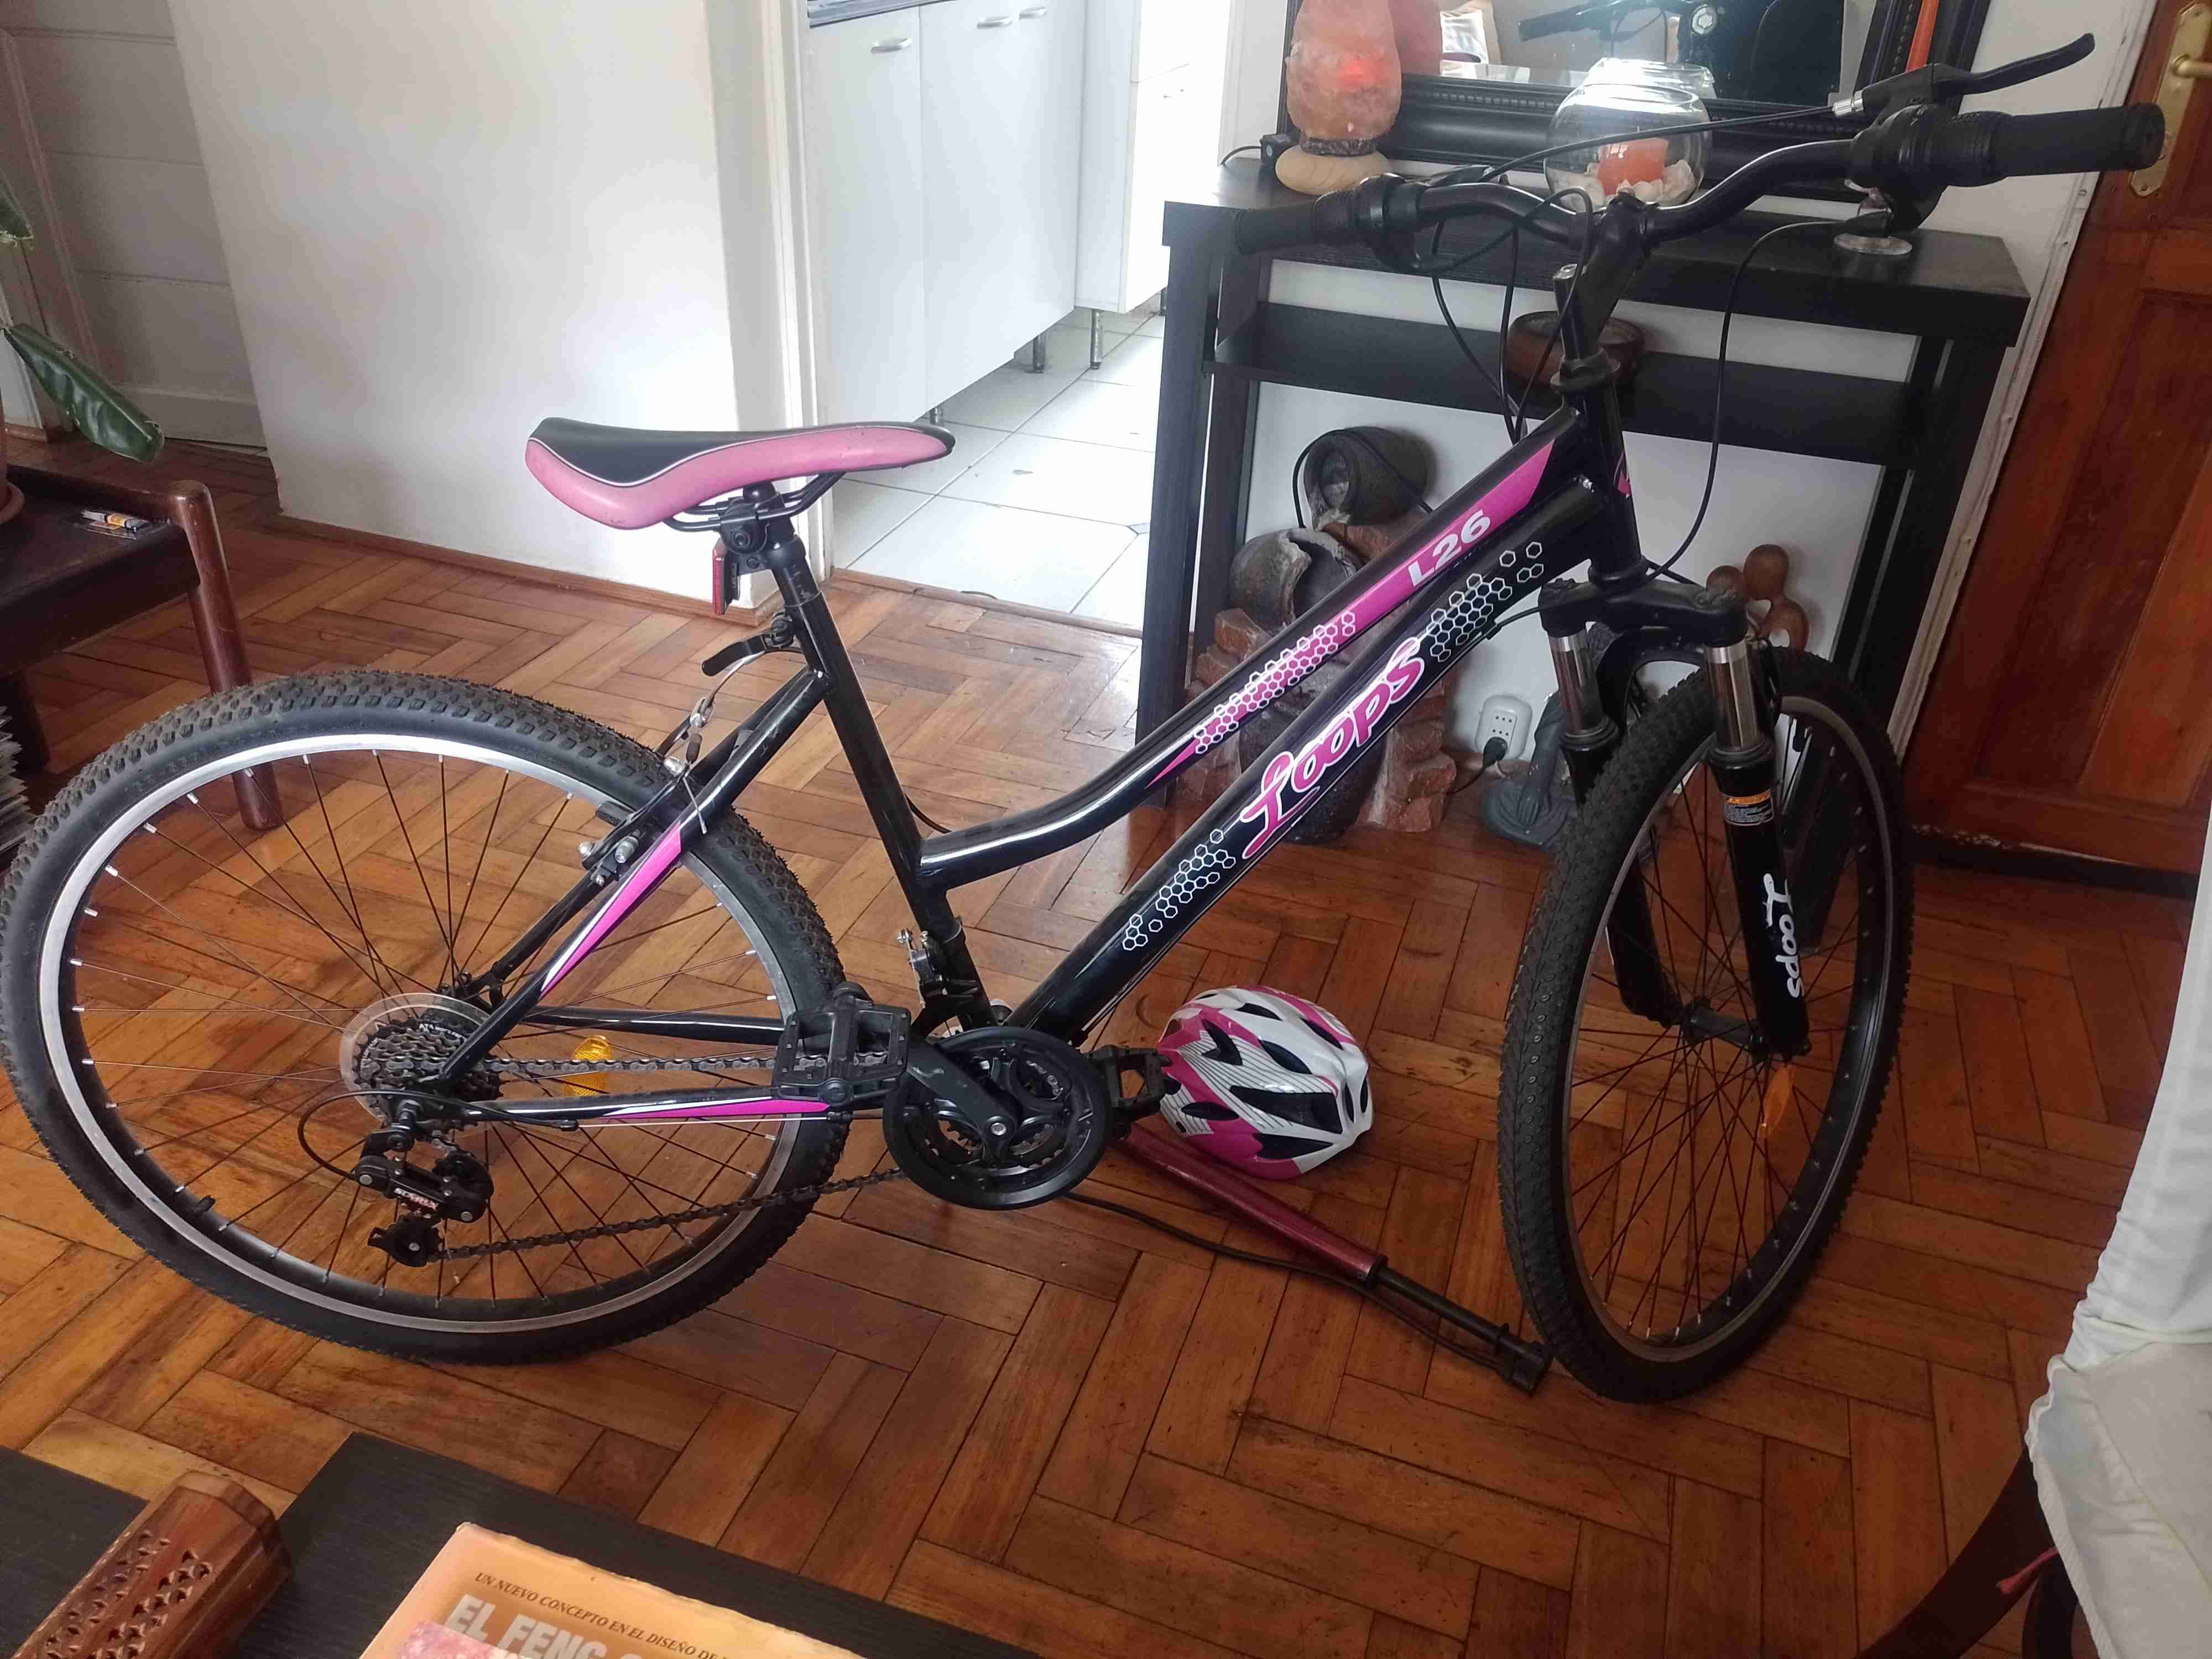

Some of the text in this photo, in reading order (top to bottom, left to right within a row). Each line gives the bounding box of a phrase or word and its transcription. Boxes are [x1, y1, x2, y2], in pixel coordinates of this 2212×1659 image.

[1408, 508, 1491, 587] L26
[1240, 637, 1425, 859] Loops
[444, 1593, 496, 1642] EL
[474, 1572, 495, 1585] UN
[497, 1580, 539, 1601] NUEVO
[539, 1596, 609, 1626] CONCEPTO
[608, 1620, 630, 1634] EN
[628, 1627, 644, 1640] EL
[646, 1633, 696, 1656] DISEÑO
